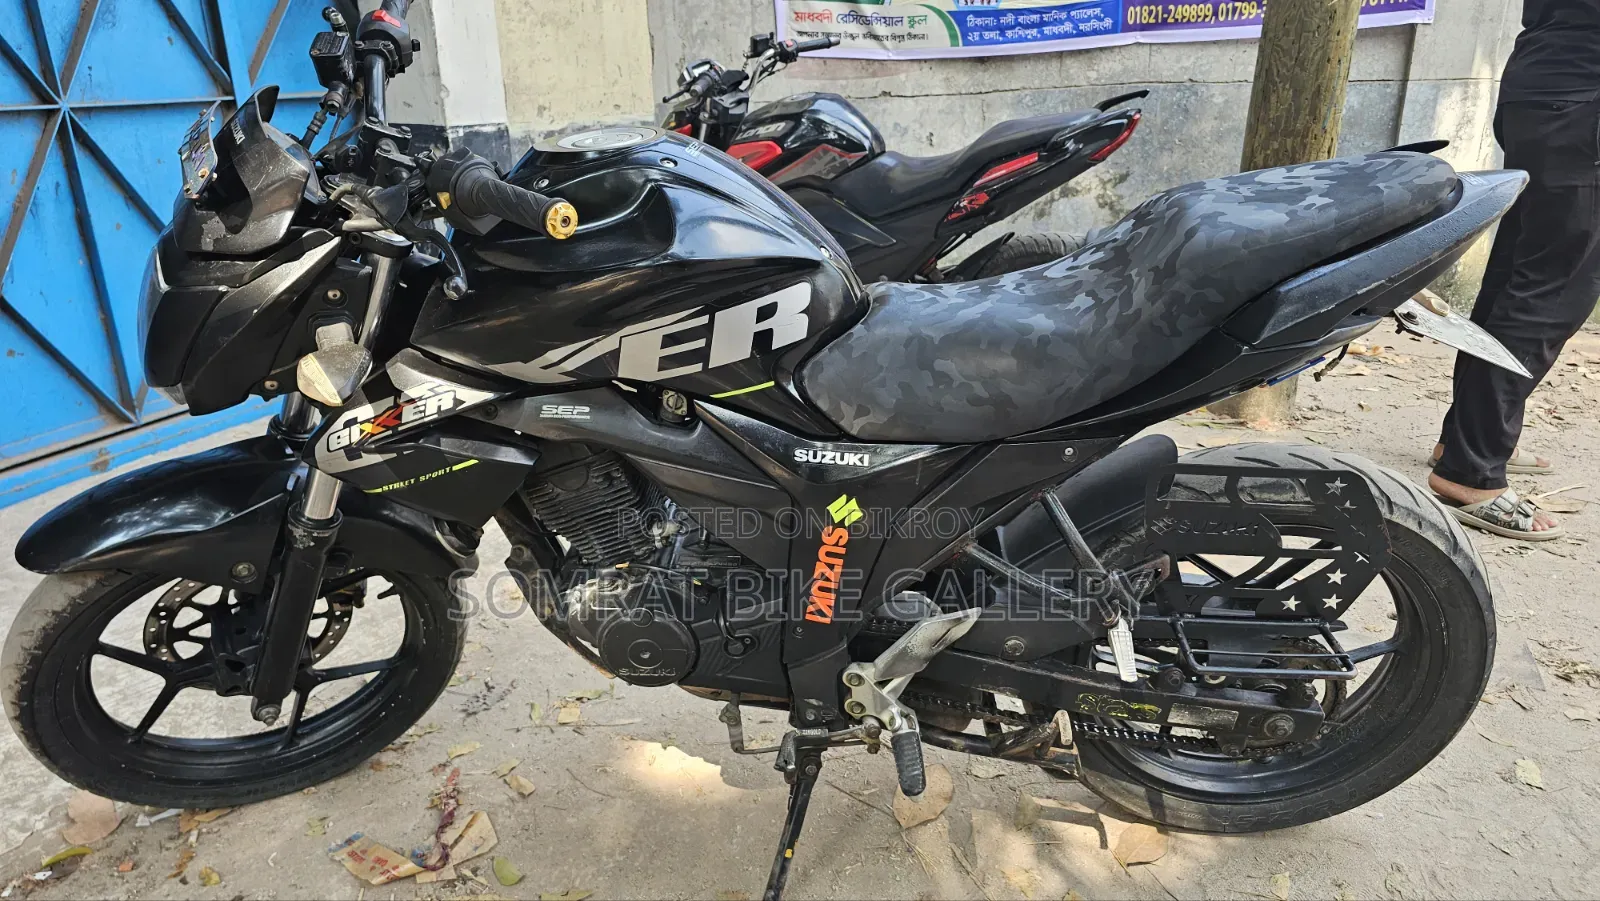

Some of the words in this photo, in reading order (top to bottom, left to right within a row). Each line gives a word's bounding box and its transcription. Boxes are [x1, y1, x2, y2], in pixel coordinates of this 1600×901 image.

[794, 9, 833, 24] মাধবদী
[907, 14, 928, 29] স্কুল
[999, 13, 1016, 26] নদী
[1127, 3, 1215, 24] 01821-249899,
[967, 31, 980, 42] ২য়
[1043, 22, 1077, 35] মাধবদী,
[1078, 18, 1114, 33] নরসিংদী
[541, 405, 590, 415] SEP
[794, 449, 871, 467] SUZUKI
[419, 466, 452, 482] SPORT
[805, 525, 849, 625] SUZUKI
[619, 667, 677, 677] SUZUKI
